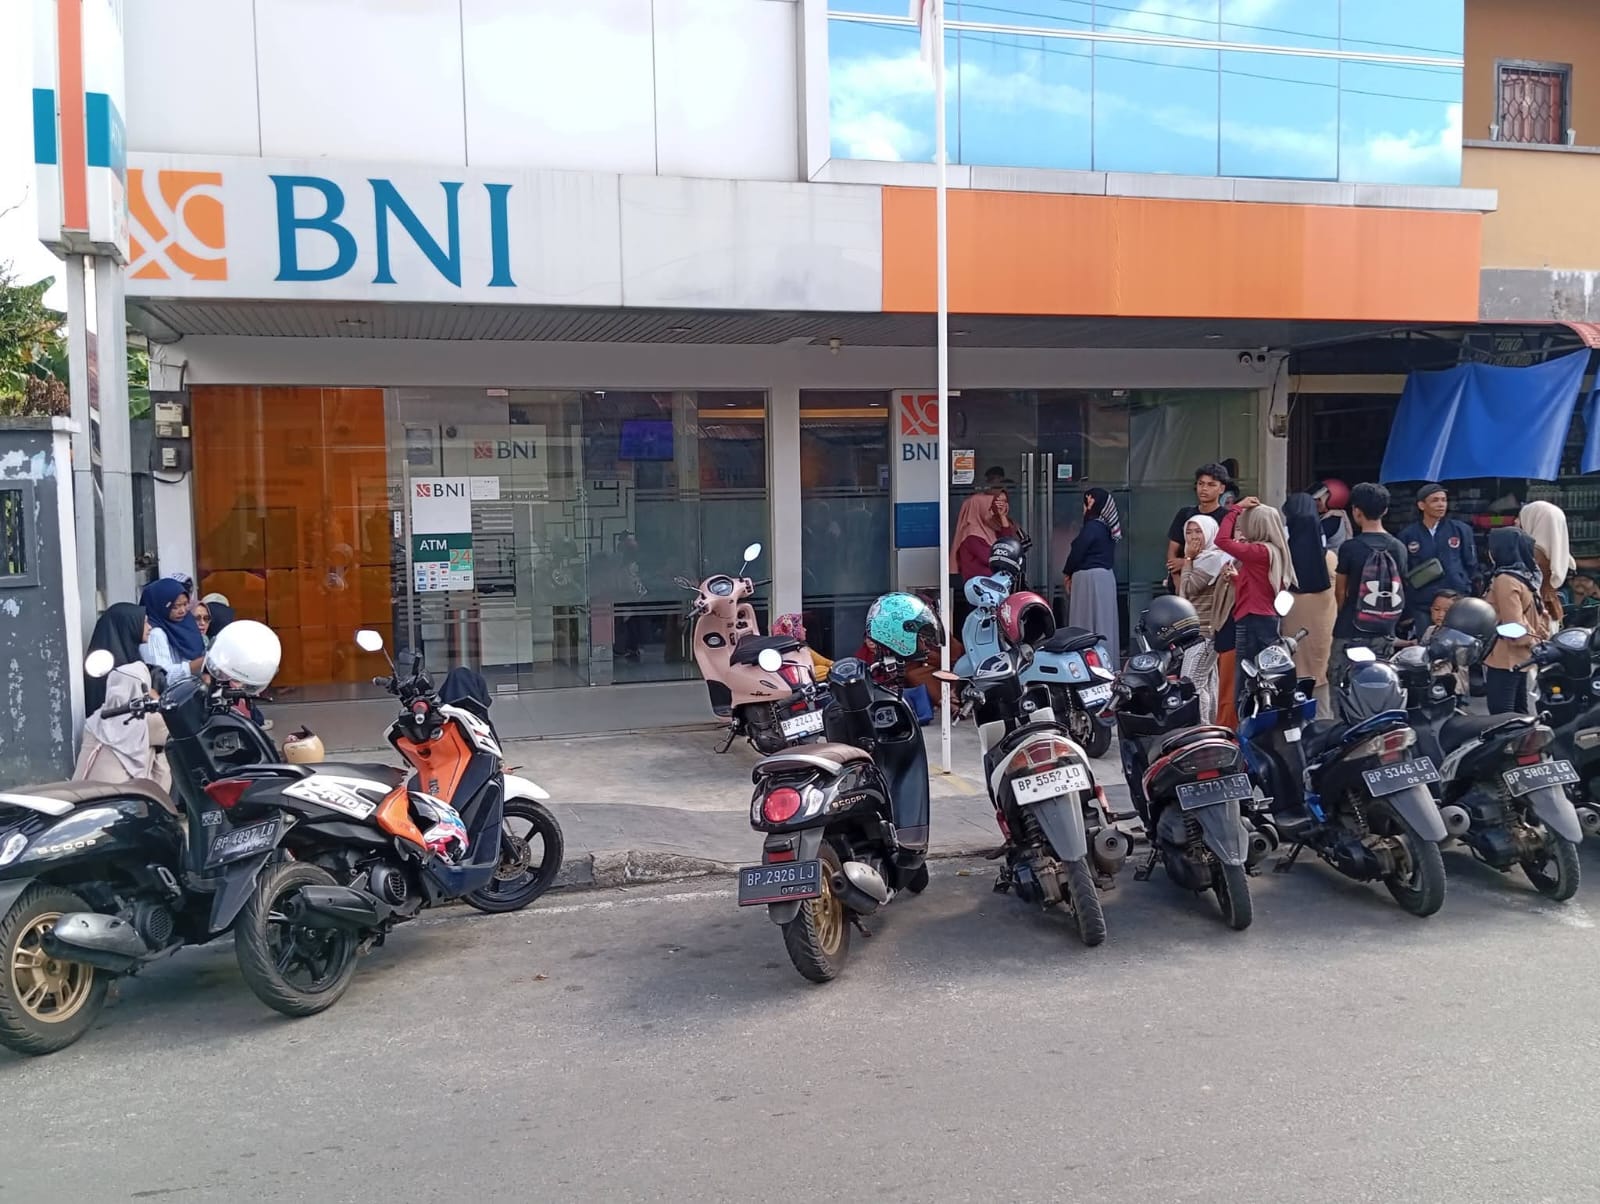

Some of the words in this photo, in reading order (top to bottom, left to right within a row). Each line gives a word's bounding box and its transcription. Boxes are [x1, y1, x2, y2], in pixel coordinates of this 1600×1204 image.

[268, 174, 518, 288] BNI
[497, 440, 537, 460] BNI
[902, 442, 939, 462] BNI
[433, 483, 465, 498] BNI
[419, 539, 448, 551] ATM
[450, 550, 472, 564] 24
[1018, 778, 1032, 792] BP
[1065, 767, 1081, 779] LD
[1367, 771, 1382, 784] BP
[1384, 763, 1413, 779] 5346
[1414, 759, 1430, 772] LF
[1506, 771, 1521, 785] BP
[1523, 765, 1552, 779] 5802
[1554, 762, 1570, 773] LG
[1180, 785, 1195, 797] BP
[214, 836, 229, 851] BP
[260, 823, 275, 838] LD
[747, 872, 761, 887] BP
[766, 868, 796, 884] 2926
[799, 866, 814, 880] LJ
